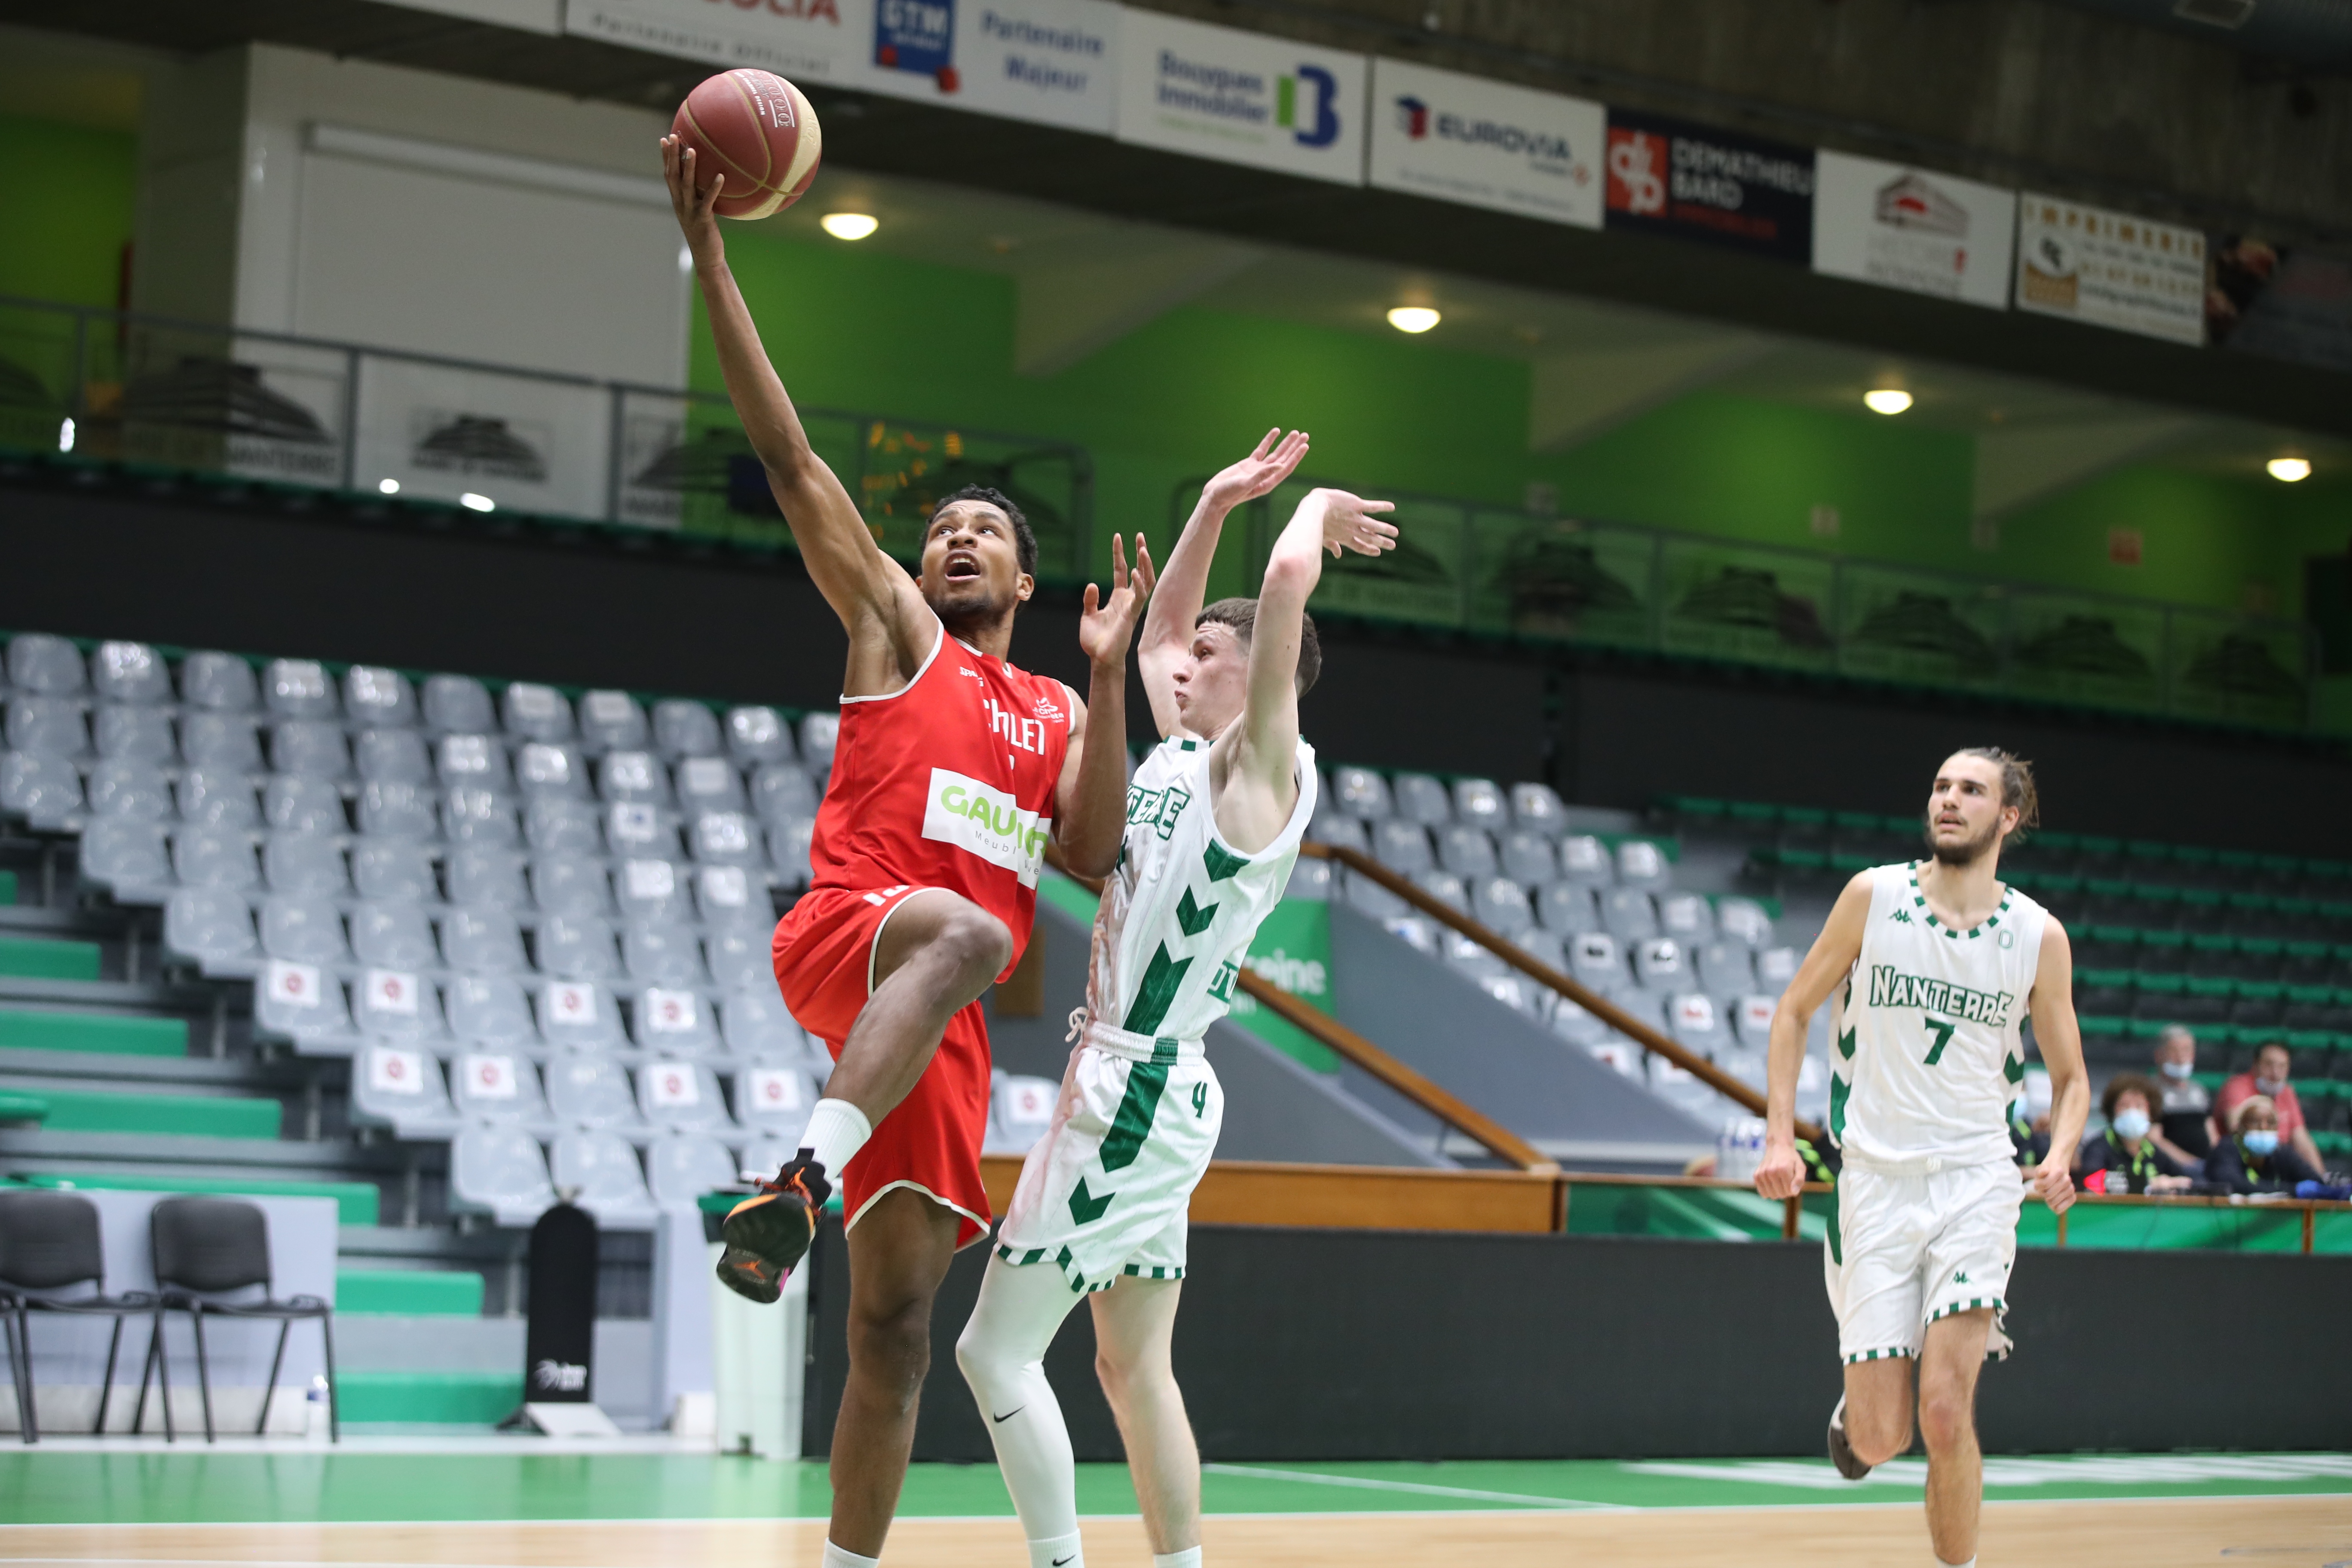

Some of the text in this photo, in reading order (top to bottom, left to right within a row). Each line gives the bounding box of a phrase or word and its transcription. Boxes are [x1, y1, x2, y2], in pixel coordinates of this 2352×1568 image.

[1159, 48, 1264, 95] Bouygues
[754, 95, 766, 116] DESIGN
[1158, 83, 1269, 124] Immobilier
[1437, 113, 1571, 159] EUROVIA
[1869, 965, 2014, 1028] NANTERRE
[1923, 1017, 1955, 1065] 7
[1191, 1080, 1208, 1118] 4
